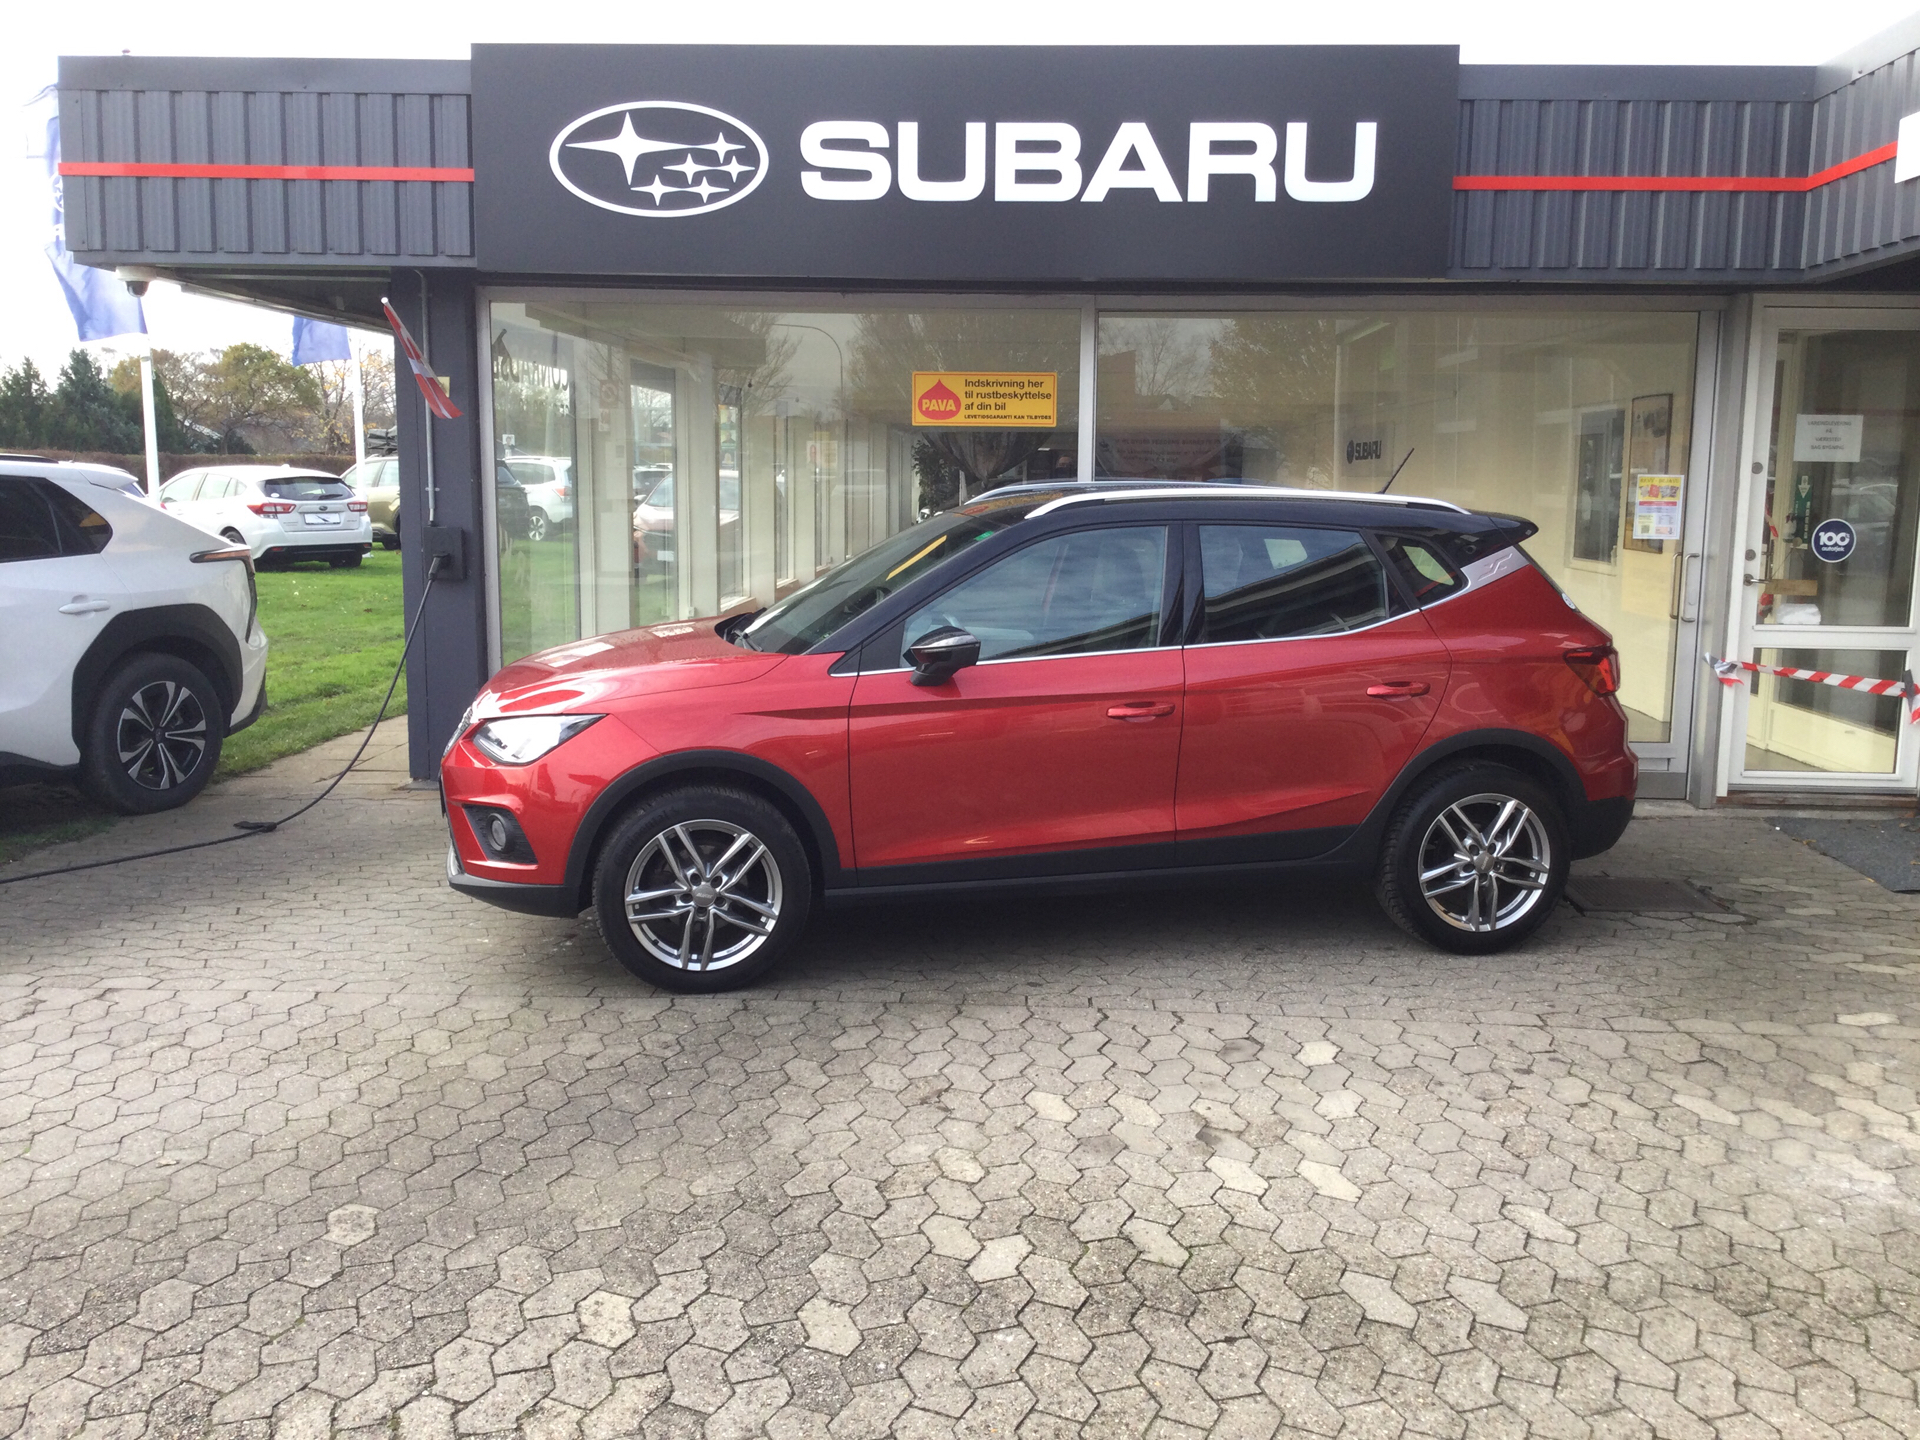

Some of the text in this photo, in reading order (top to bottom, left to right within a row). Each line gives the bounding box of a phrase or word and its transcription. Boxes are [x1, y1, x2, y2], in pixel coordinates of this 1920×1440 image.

[800, 120, 1378, 202] SUBARU
[964, 378, 1044, 389] Indskrivning her
[964, 390, 1052, 401] til rustbeskyttelse
[921, 399, 957, 411] PAVA
[964, 402, 1006, 411] af din bil
